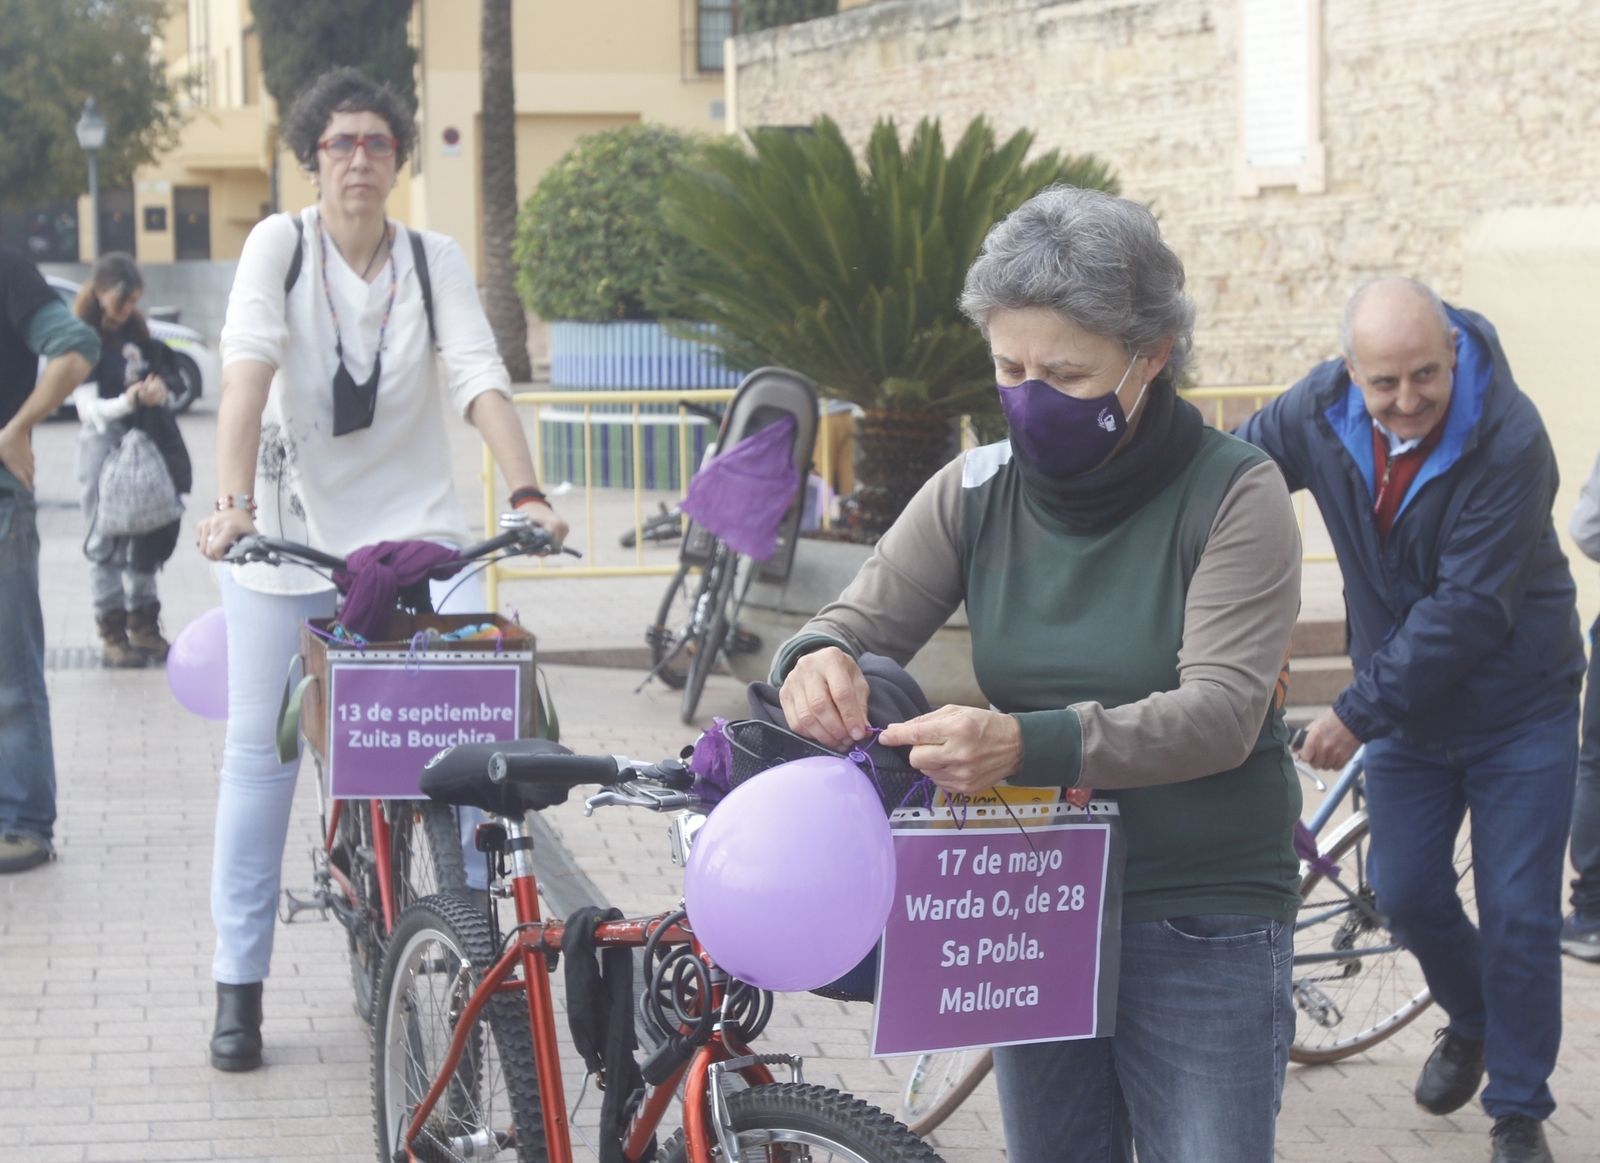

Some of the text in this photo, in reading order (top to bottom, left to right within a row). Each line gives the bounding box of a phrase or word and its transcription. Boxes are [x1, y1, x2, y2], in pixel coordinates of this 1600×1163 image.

[338, 702, 513, 726] 13 de septiembre
[348, 728, 496, 748] Zuita Bouchira
[937, 846, 1063, 877] 17 de mayo
[905, 889, 985, 921] Warda
[1025, 885, 1050, 914] de
[1056, 884, 1085, 912] 28
[940, 932, 1045, 967] Sa Pobla.
[938, 982, 1039, 1014] Mallorca
